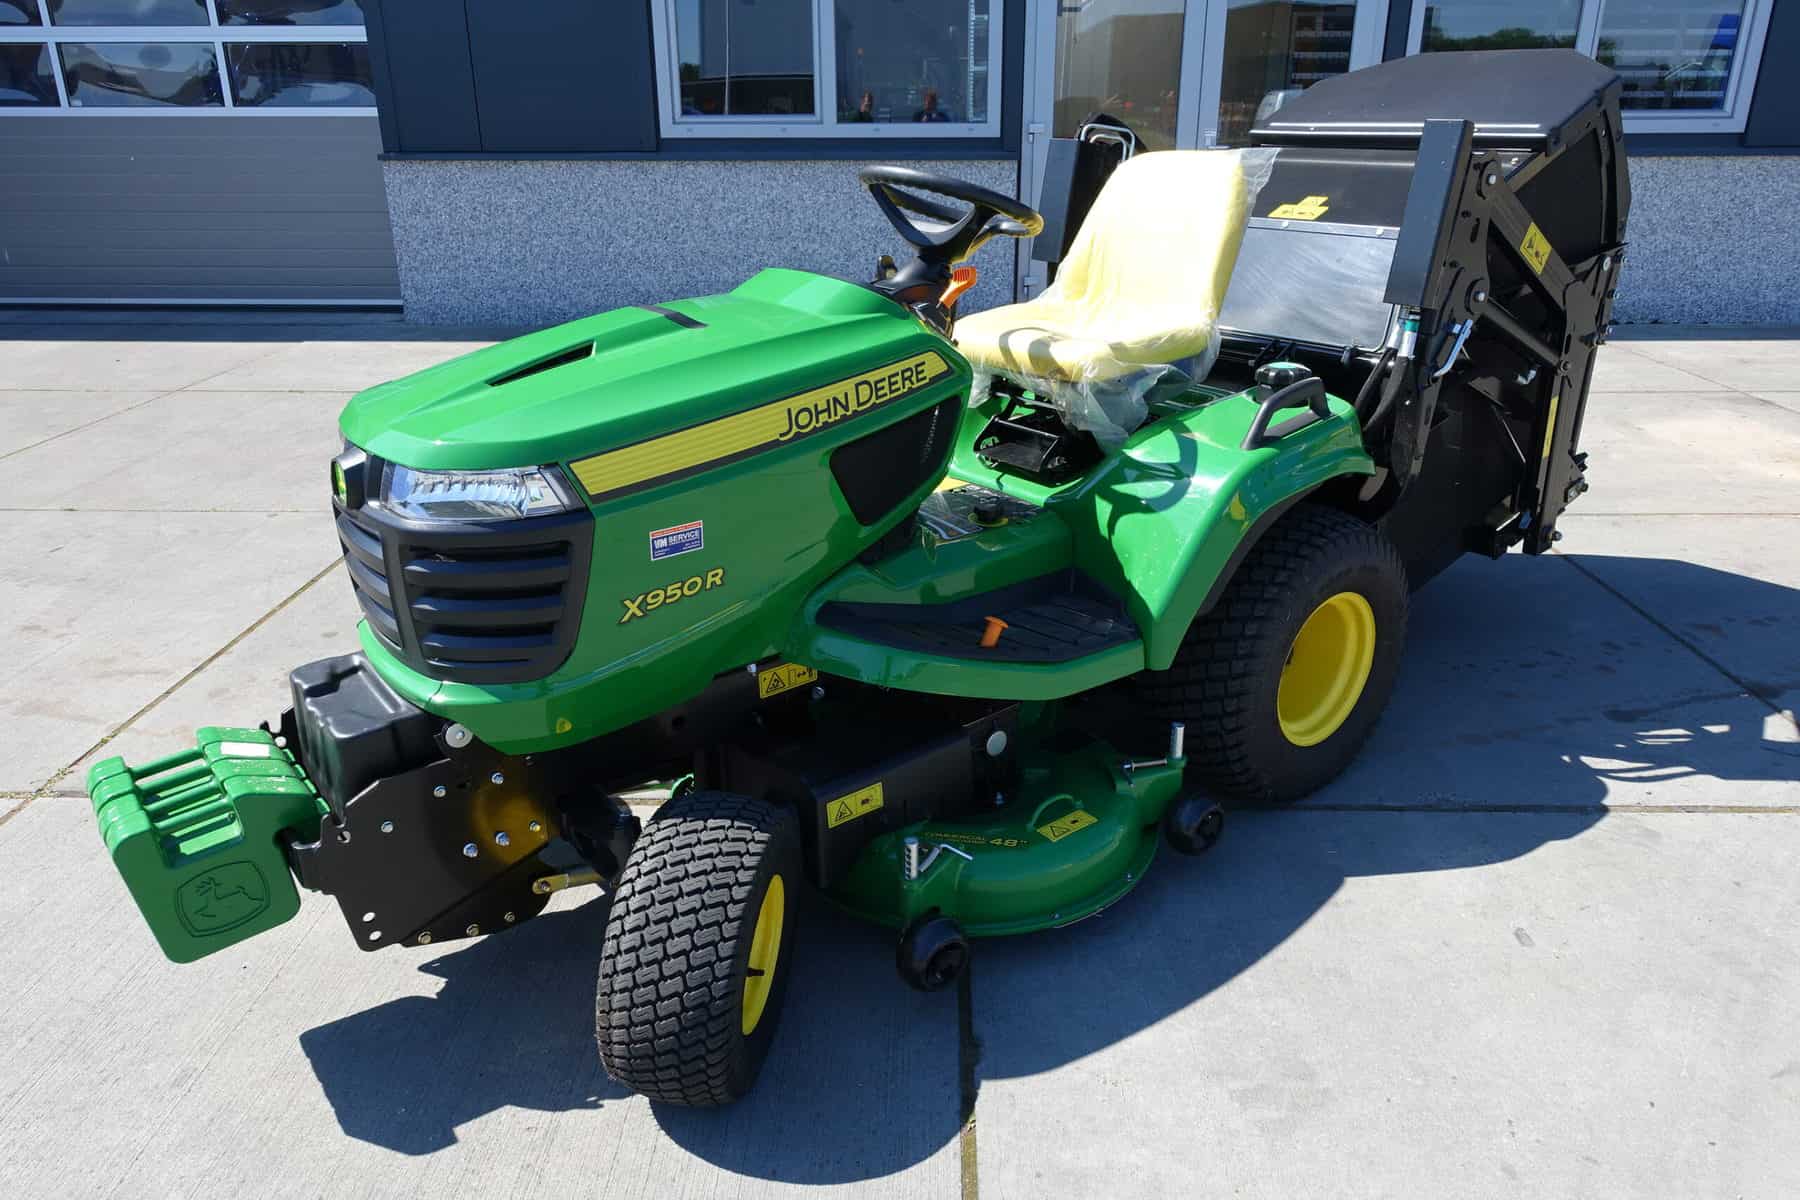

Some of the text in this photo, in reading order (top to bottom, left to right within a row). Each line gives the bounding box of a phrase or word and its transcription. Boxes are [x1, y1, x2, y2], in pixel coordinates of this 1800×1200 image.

[779, 360, 928, 438] JOHN DEERE
[668, 529, 700, 545] SERVICE
